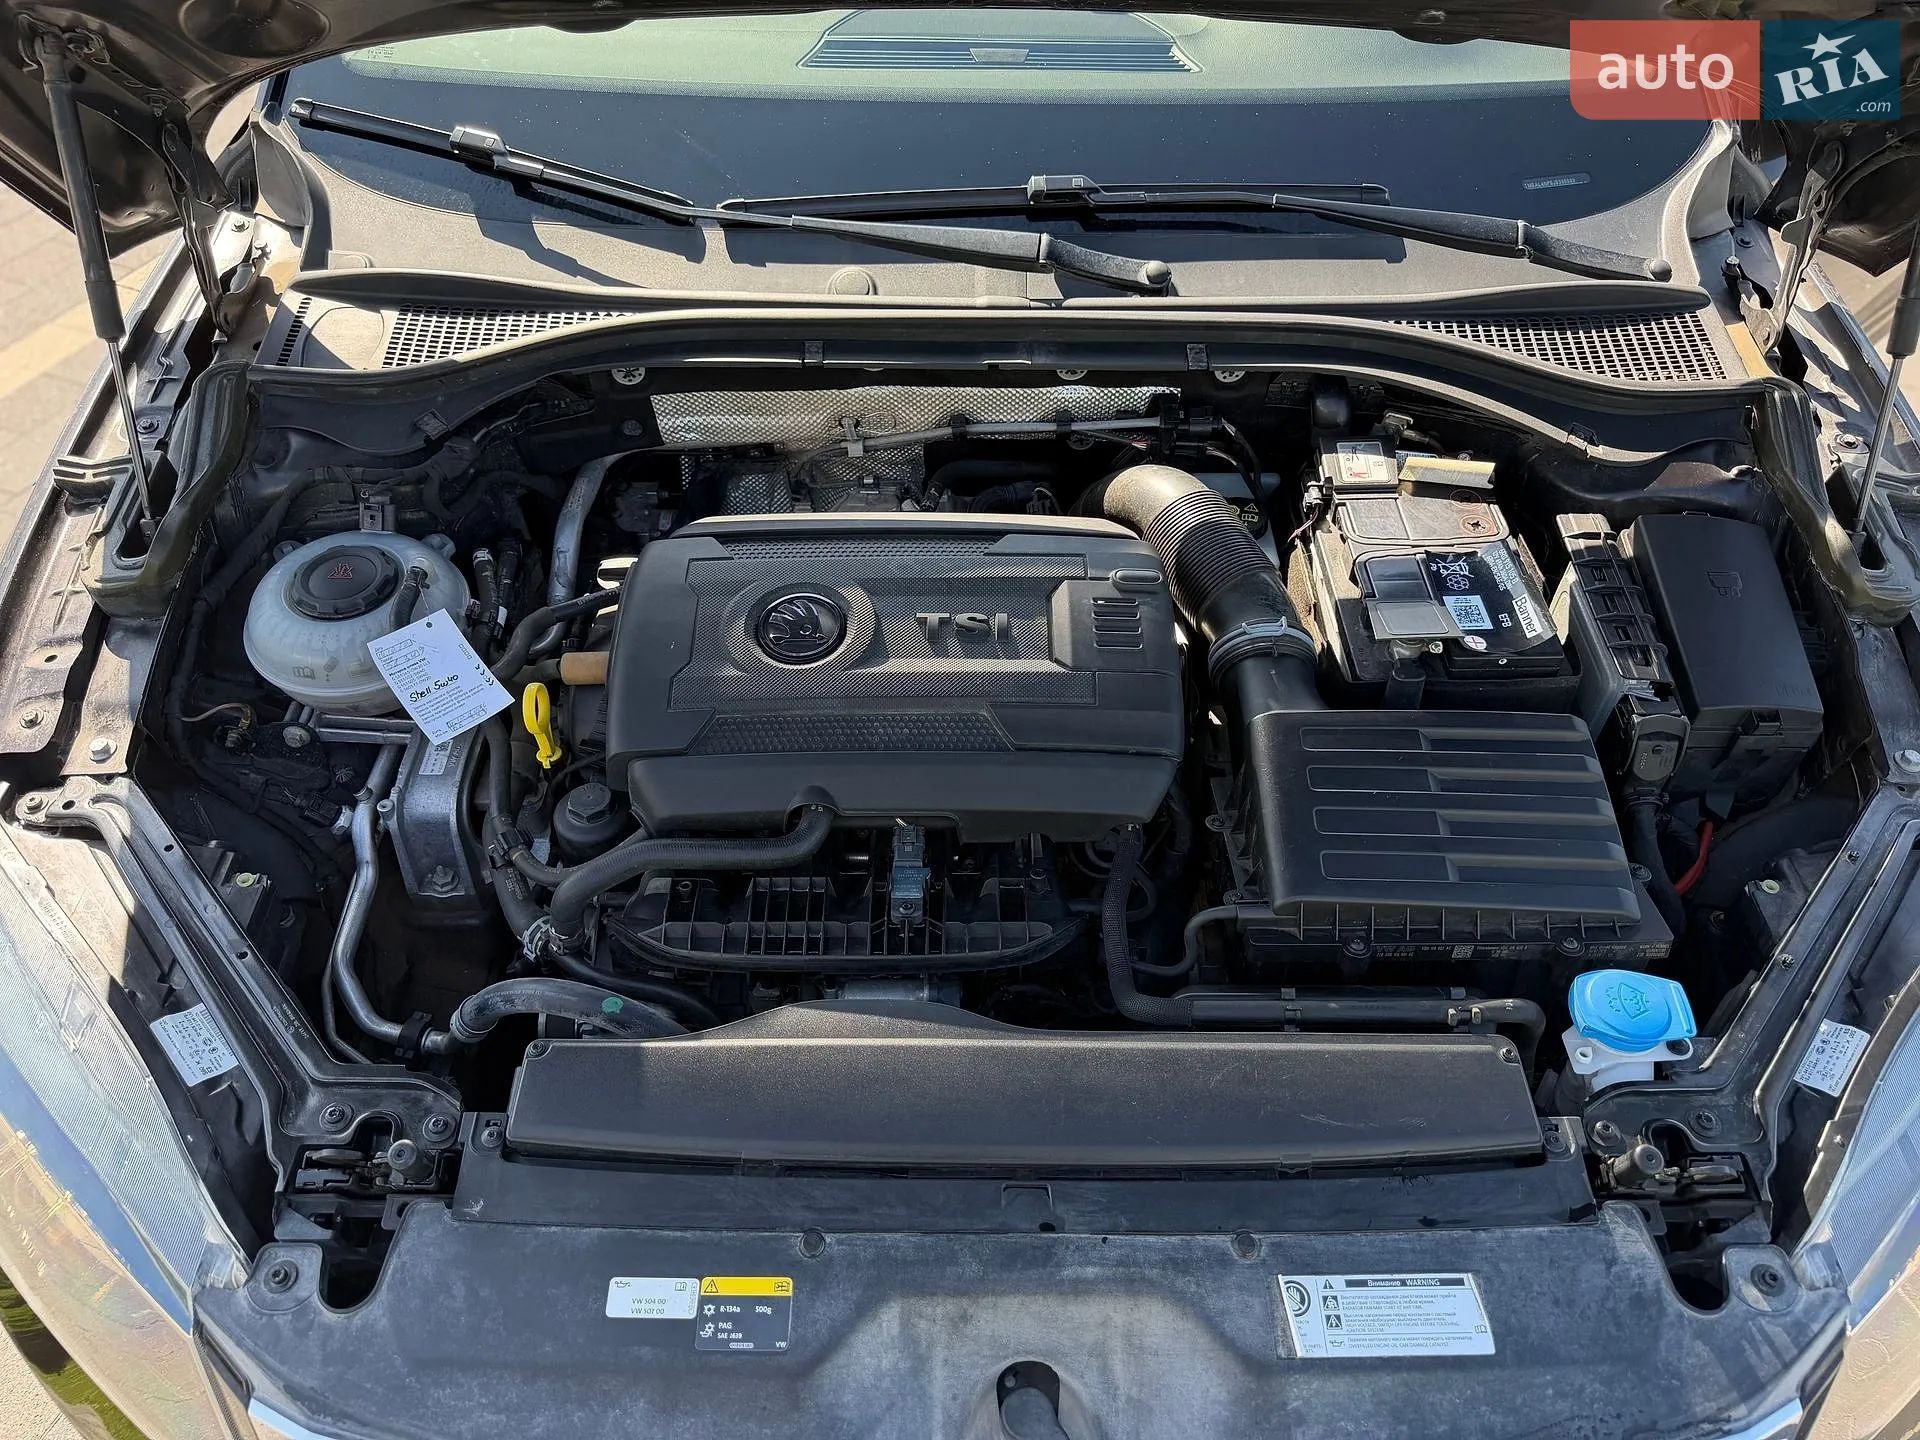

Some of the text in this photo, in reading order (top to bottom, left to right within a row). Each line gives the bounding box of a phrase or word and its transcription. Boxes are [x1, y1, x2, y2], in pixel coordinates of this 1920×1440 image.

[1498, 613, 1512, 628] EFB
[1514, 596, 1539, 634] Banner
[916, 612, 1009, 642] TSI
[409, 686, 432, 703] Shell
[1405, 1278, 1441, 1287] WARNING
[719, 1305, 772, 1315] R-134a 500g
